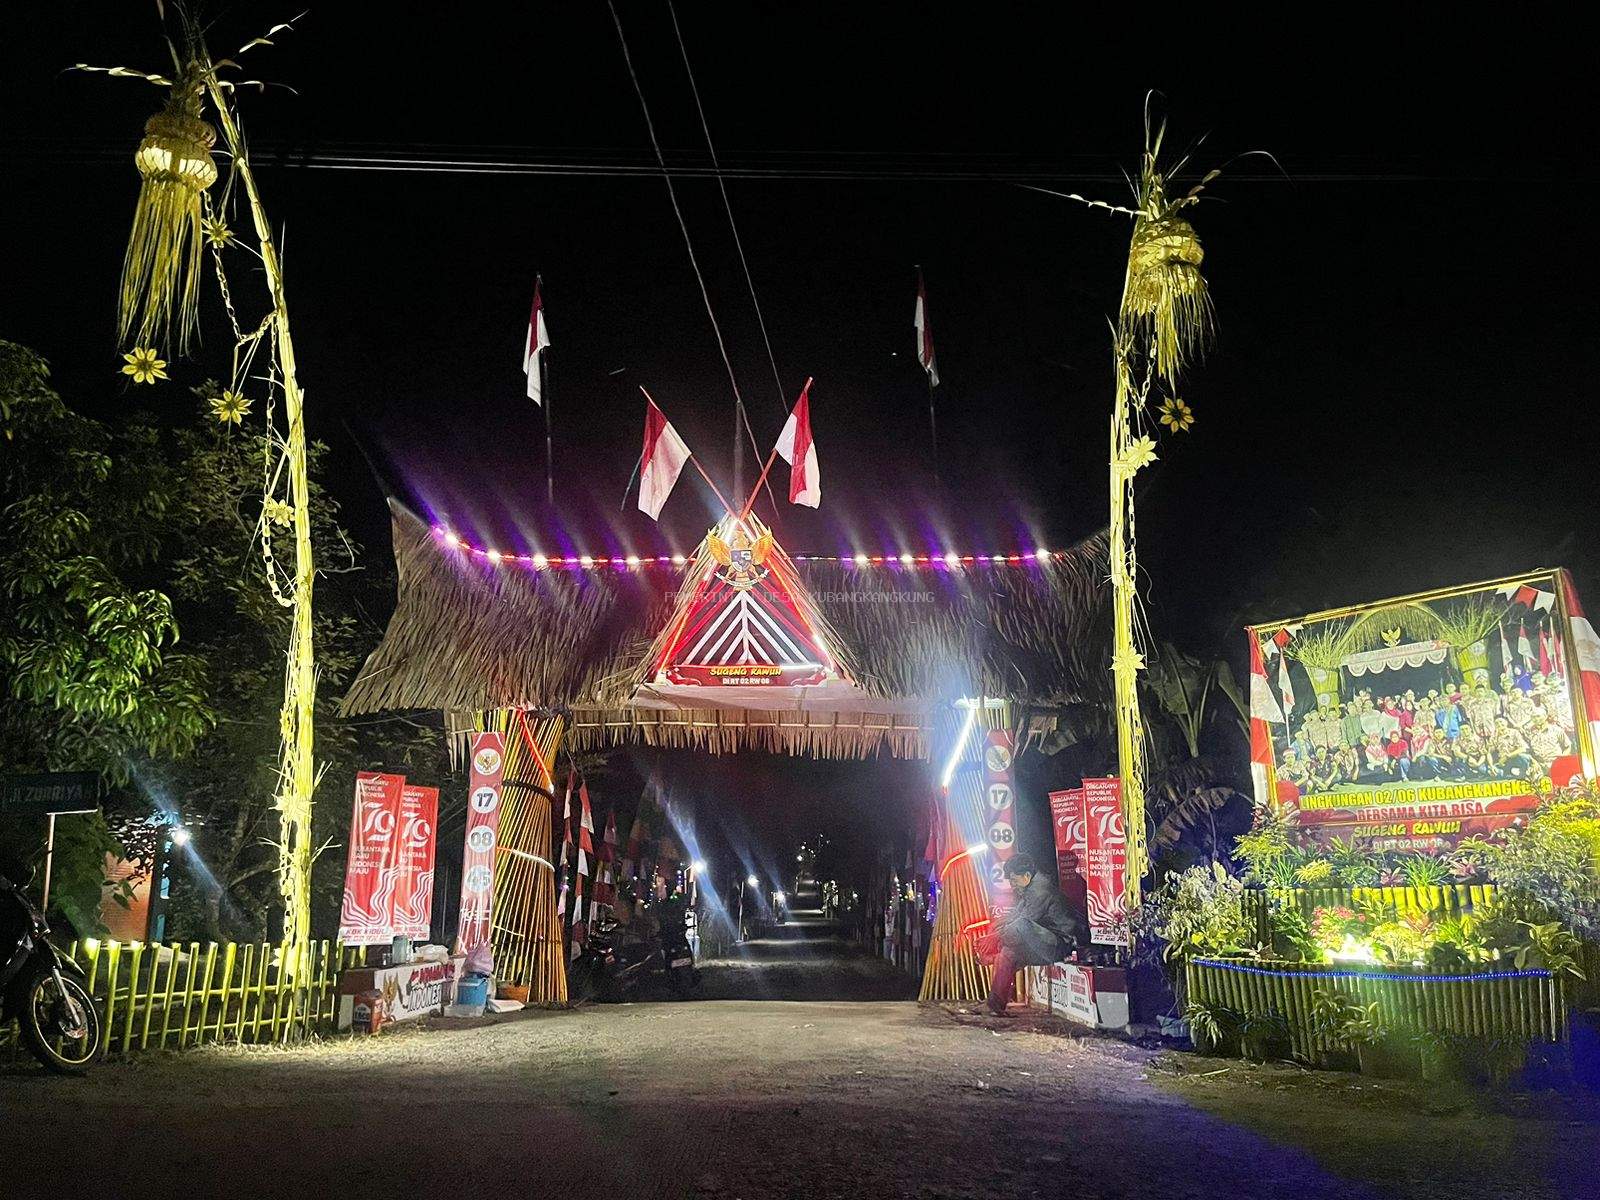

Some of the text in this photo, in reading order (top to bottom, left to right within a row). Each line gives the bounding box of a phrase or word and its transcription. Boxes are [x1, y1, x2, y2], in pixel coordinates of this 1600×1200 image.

[709, 667, 748, 676] SUGENG
[476, 791, 494, 807] 17
[991, 789, 1009, 804] 17
[1299, 776, 1553, 811] LINGKUNGAN 02/06 KUBANGKANGKG
[1356, 805, 1417, 821] BERSAMA
[1418, 803, 1450, 818] KITA
[991, 828, 1012, 843] 08
[1353, 823, 1407, 838] SUGENG
[470, 831, 493, 847] 08
[1089, 848, 1126, 856] NUSANTAR
[991, 868, 1004, 884] 2
